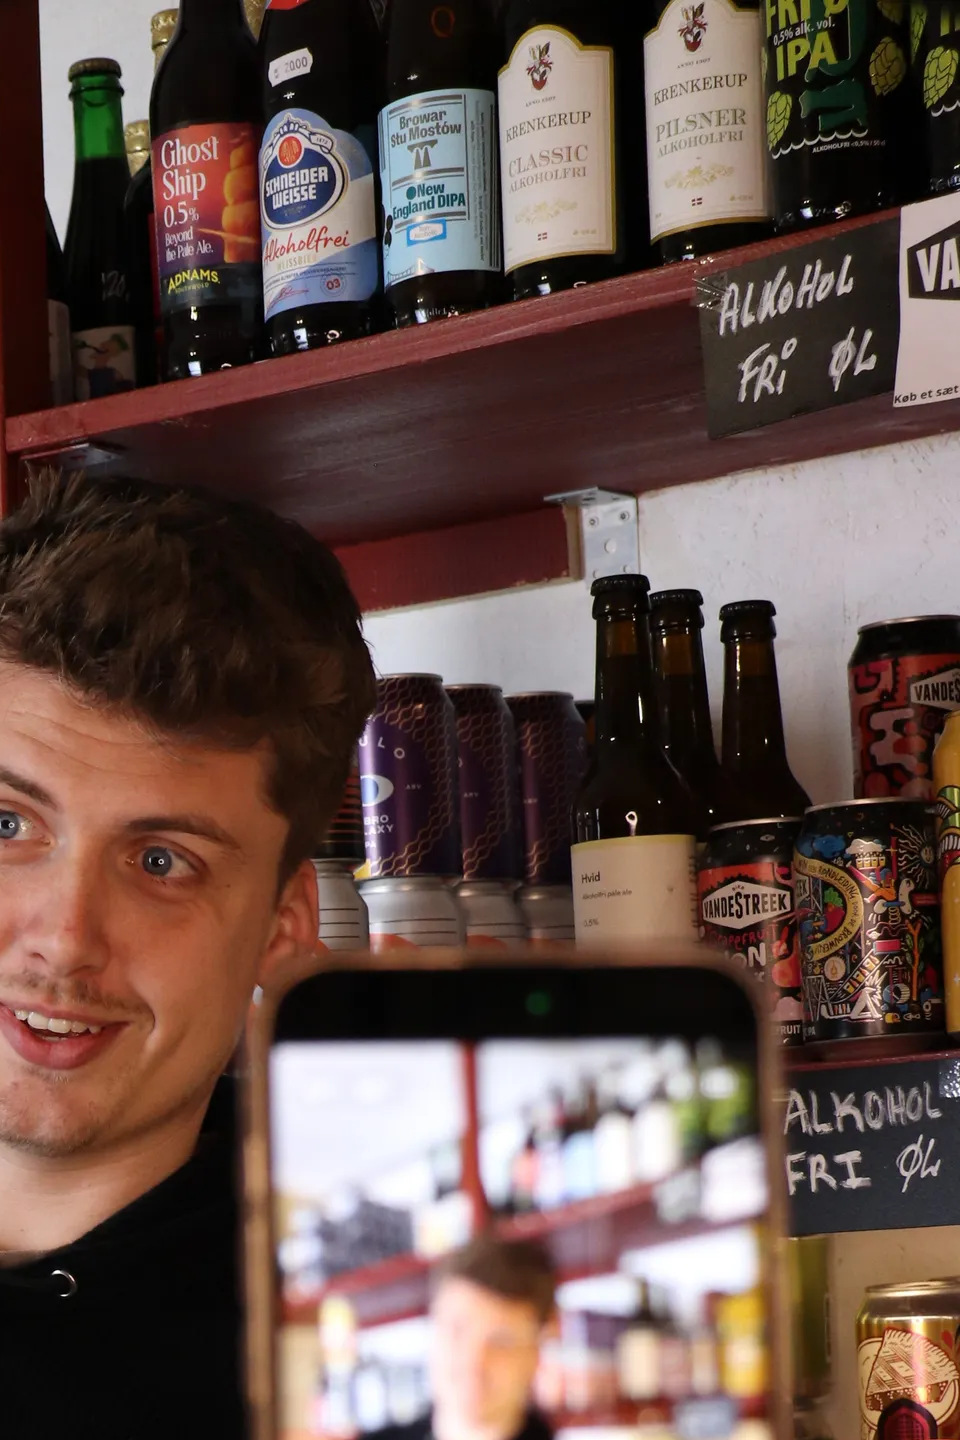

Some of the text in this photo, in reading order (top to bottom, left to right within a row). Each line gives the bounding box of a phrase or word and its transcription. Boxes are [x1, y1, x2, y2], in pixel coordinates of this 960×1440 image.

[816, 17, 836, 31] vol.
[775, 31, 839, 82] IPA
[653, 73, 748, 107] KRENKERUP
[399, 109, 447, 130] Browar
[505, 110, 592, 143] KRENKERUP
[655, 108, 748, 144] PILSNER
[390, 121, 462, 149] Stu Mostów
[656, 130, 744, 159] ALKOHOLFRI
[161, 135, 219, 170] Ghost
[508, 144, 589, 178] CLASSIC
[162, 169, 207, 201] Ship
[265, 166, 329, 196] SCHNEIDER
[416, 182, 445, 197] New
[508, 166, 587, 194] ALKOHOLFRI
[272, 183, 317, 210] WEISSE
[392, 192, 466, 220] England DIPA
[163, 201, 200, 228] 0.5%
[165, 226, 194, 247] Beyond
[166, 240, 214, 262] the Pale Ale.
[264, 225, 350, 266] Alkoholfrei
[167, 268, 219, 294] ADNAMS
[325, 278, 341, 291] 03
[719, 254, 855, 336] ALKOHOL
[828, 326, 877, 393] ØL
[893, 384, 959, 405] Køb et sæt
[581, 870, 601, 884] Hvid
[703, 891, 788, 920] VANDESTREEK
[783, 1081, 943, 1136] ALKOHOL
[785, 1134, 942, 1196] FRI ØL
